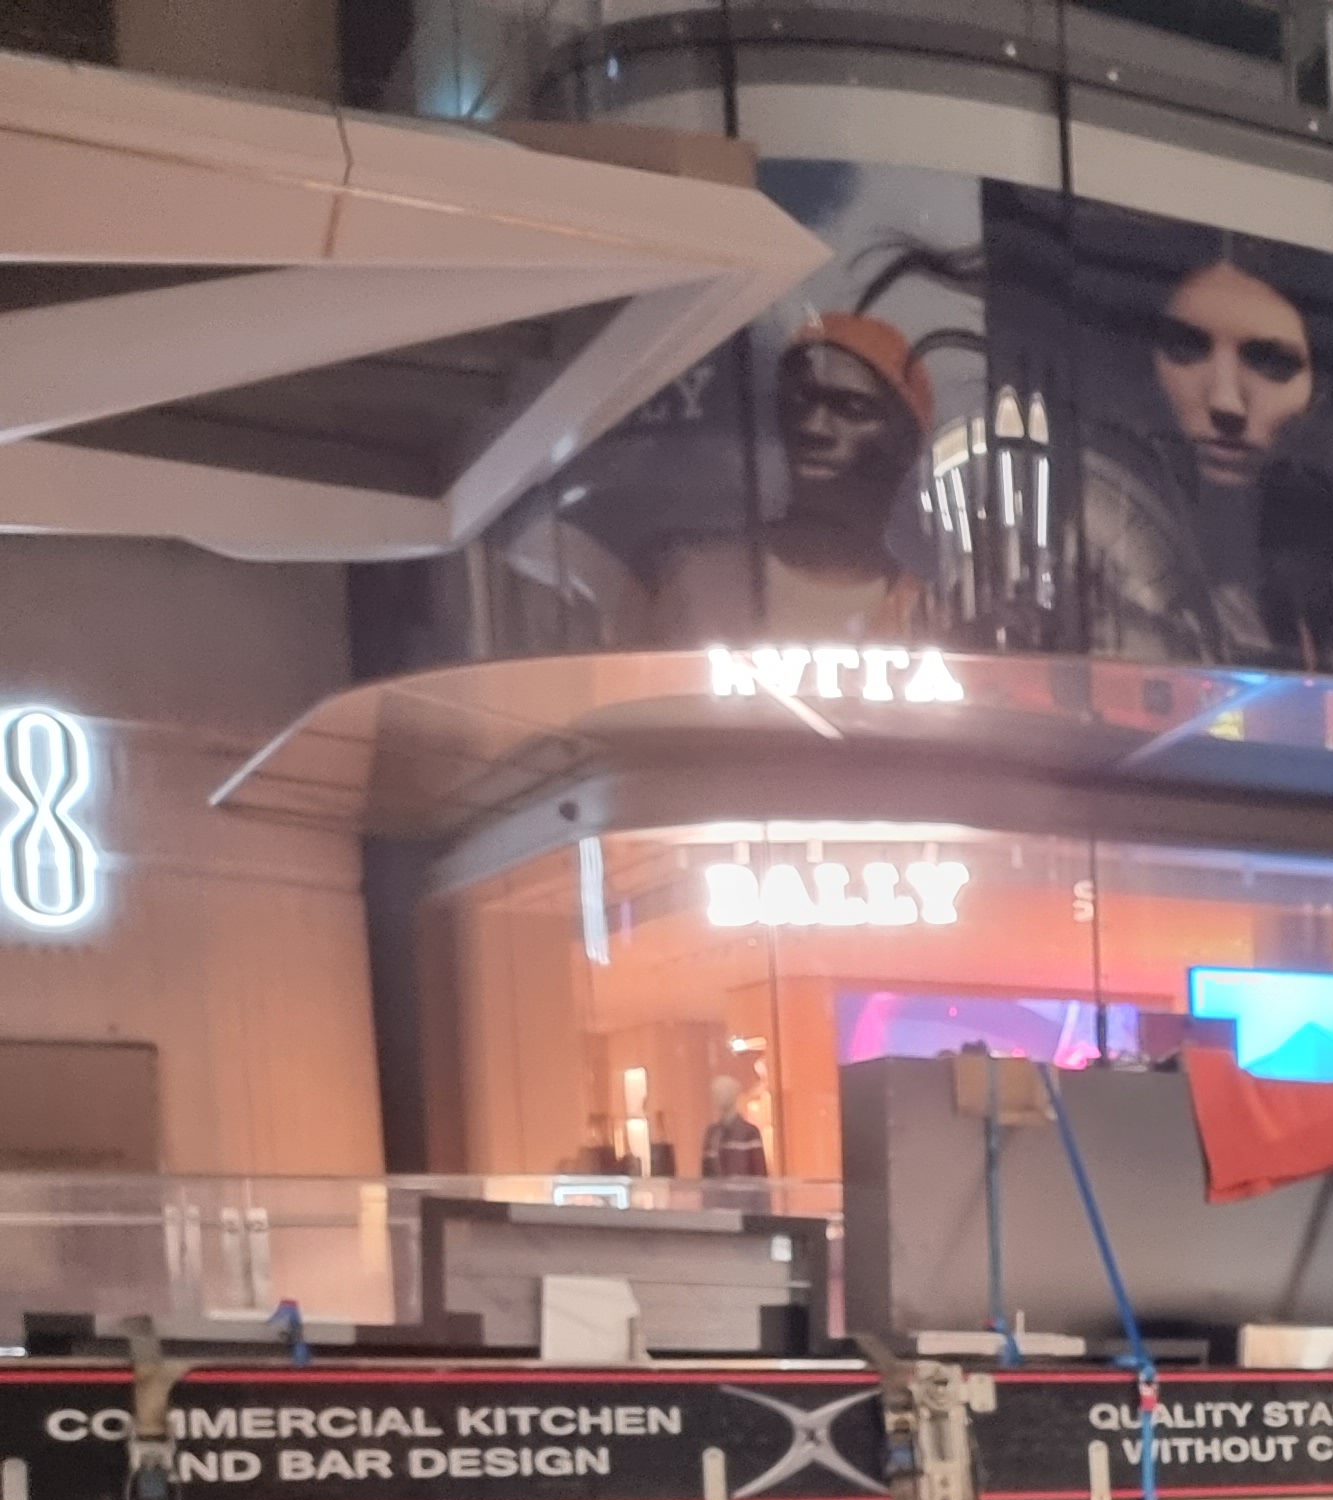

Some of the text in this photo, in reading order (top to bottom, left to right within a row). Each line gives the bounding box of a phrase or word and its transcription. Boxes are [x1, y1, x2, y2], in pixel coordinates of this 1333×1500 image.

[704, 861, 970, 926] BALLY
[457, 1405, 682, 1437] KITCHEN
[1088, 1401, 1252, 1431] QUALITY
[165, 1446, 610, 1483] ND BAR DESIGN
[1122, 1434, 1299, 1464] WITHOUT
